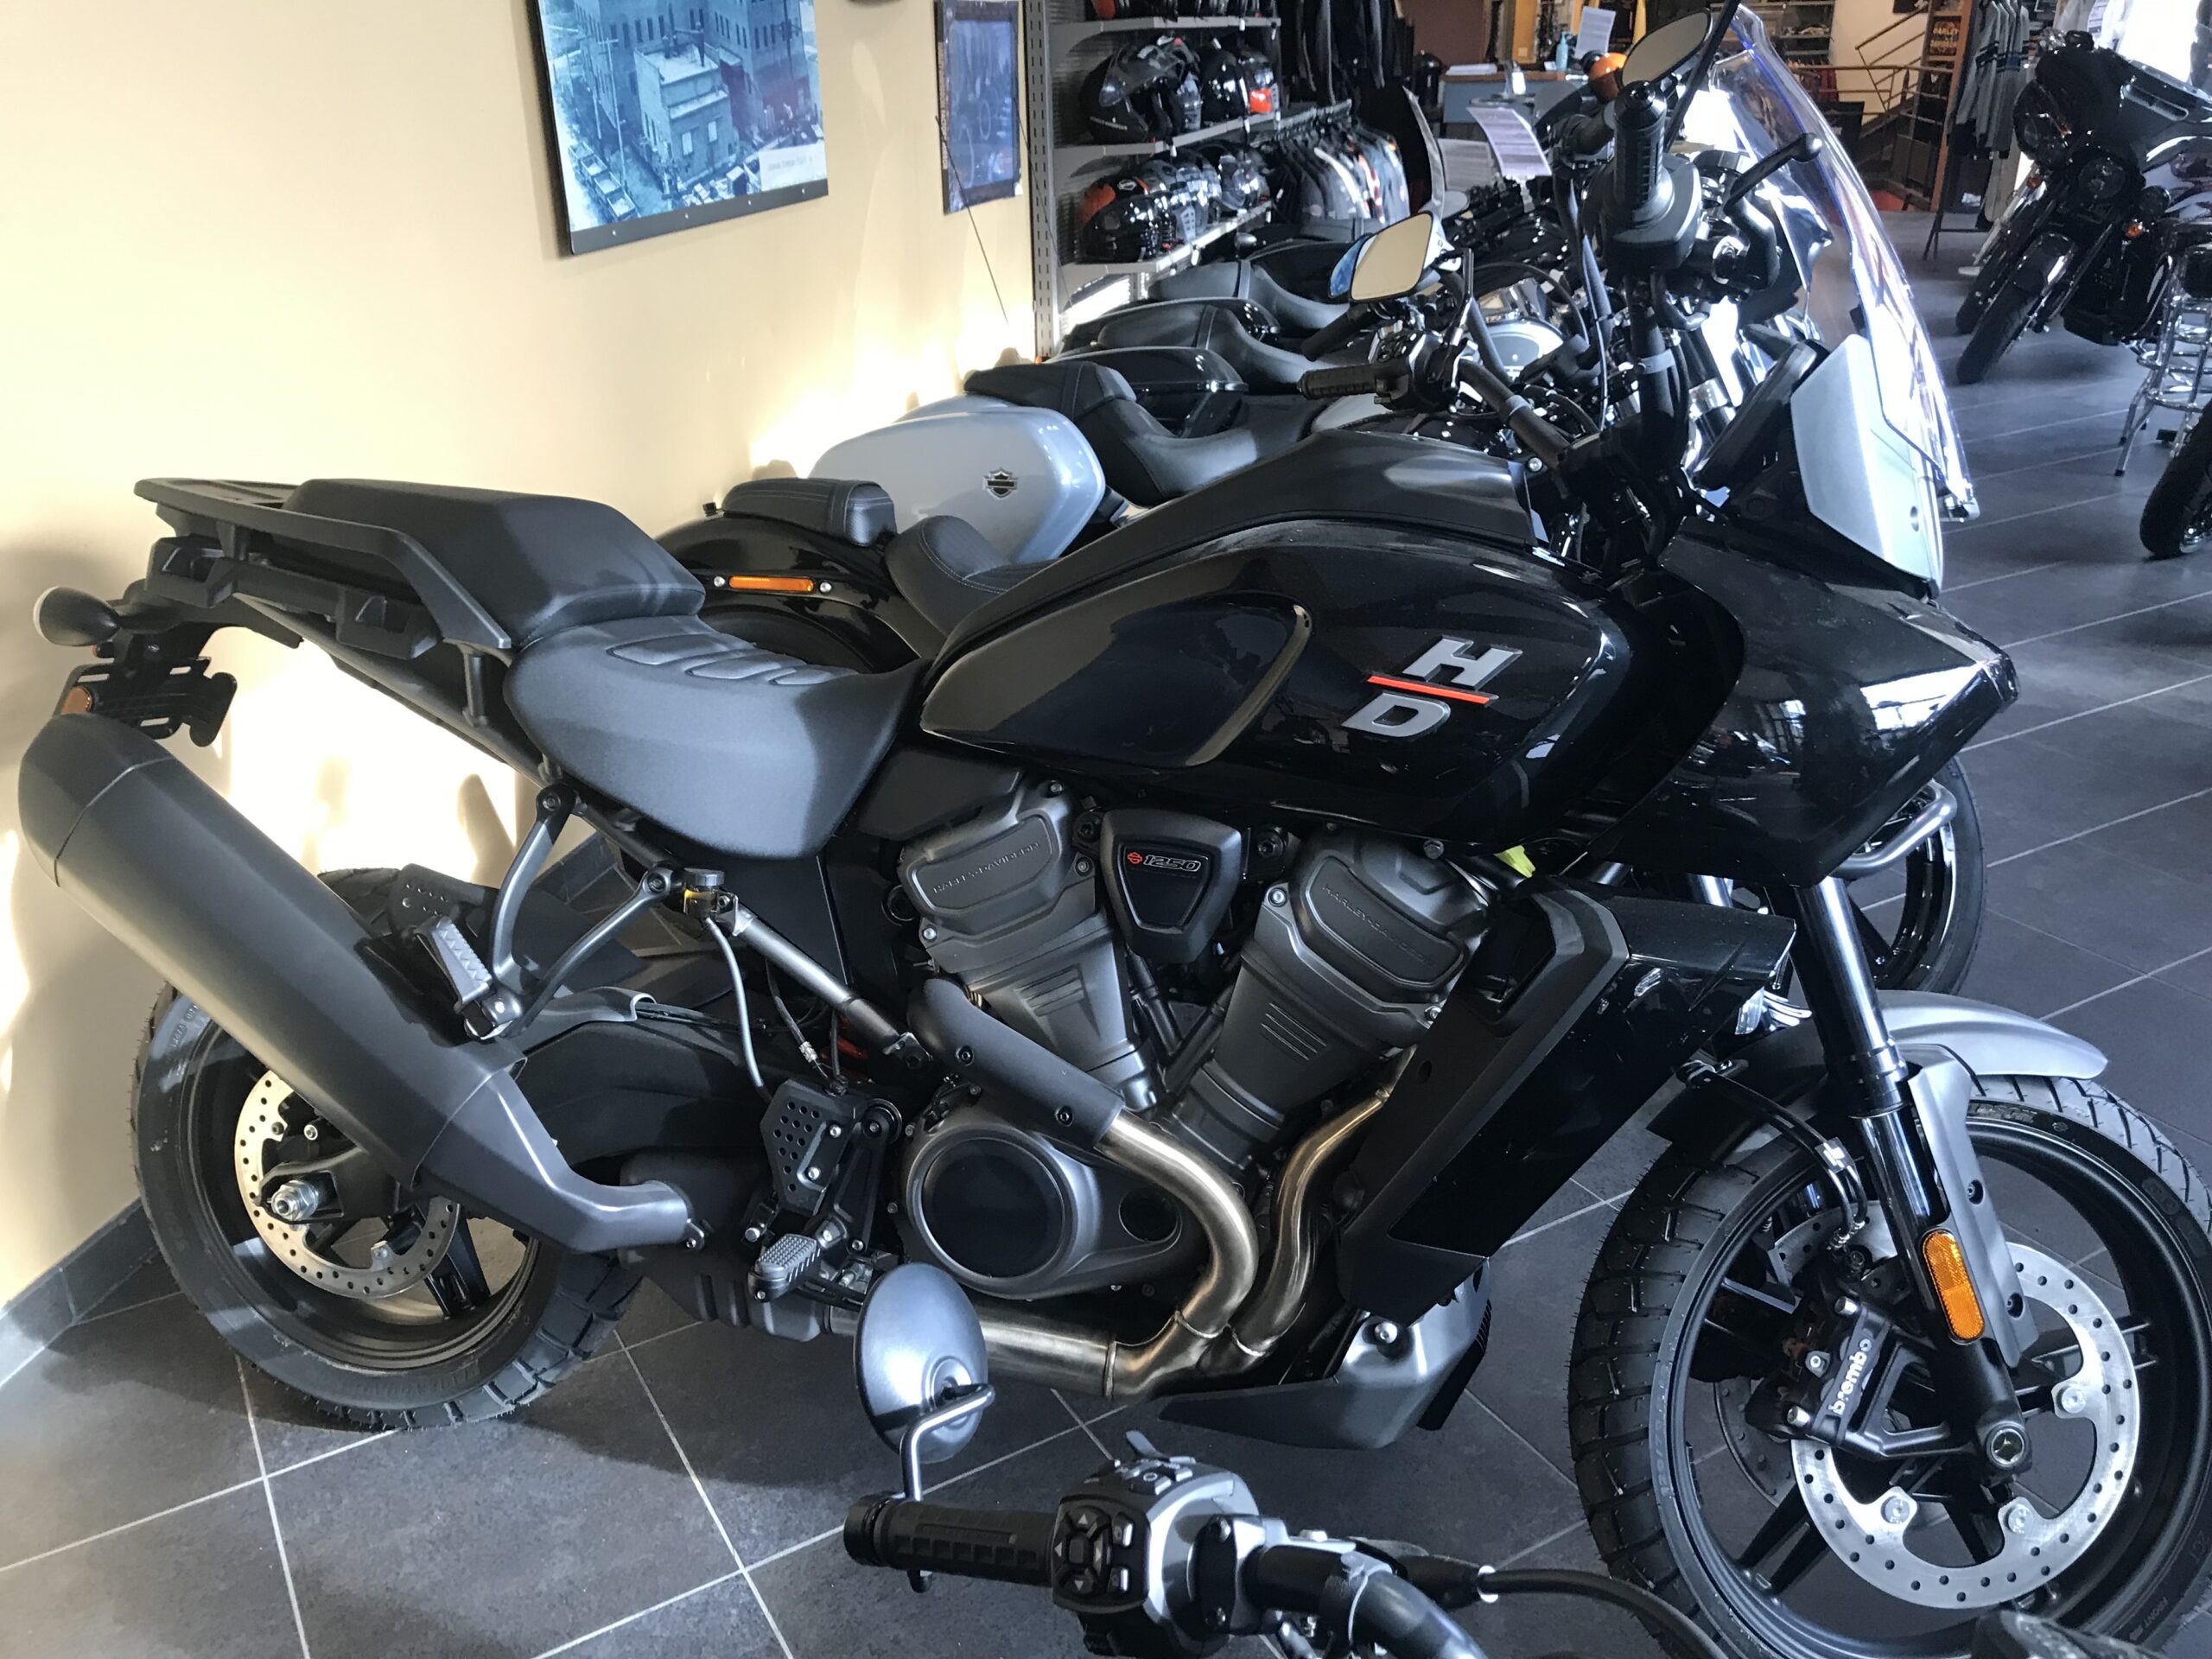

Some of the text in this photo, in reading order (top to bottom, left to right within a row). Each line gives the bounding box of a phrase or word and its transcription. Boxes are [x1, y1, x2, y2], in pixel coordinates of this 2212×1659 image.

[1402, 634, 1522, 690] H
[1341, 691, 1452, 738] D
[1143, 854, 1202, 873] 1250
[1827, 1338, 1872, 1415] brembo
[2144, 1596, 2169, 1627] FRONT
